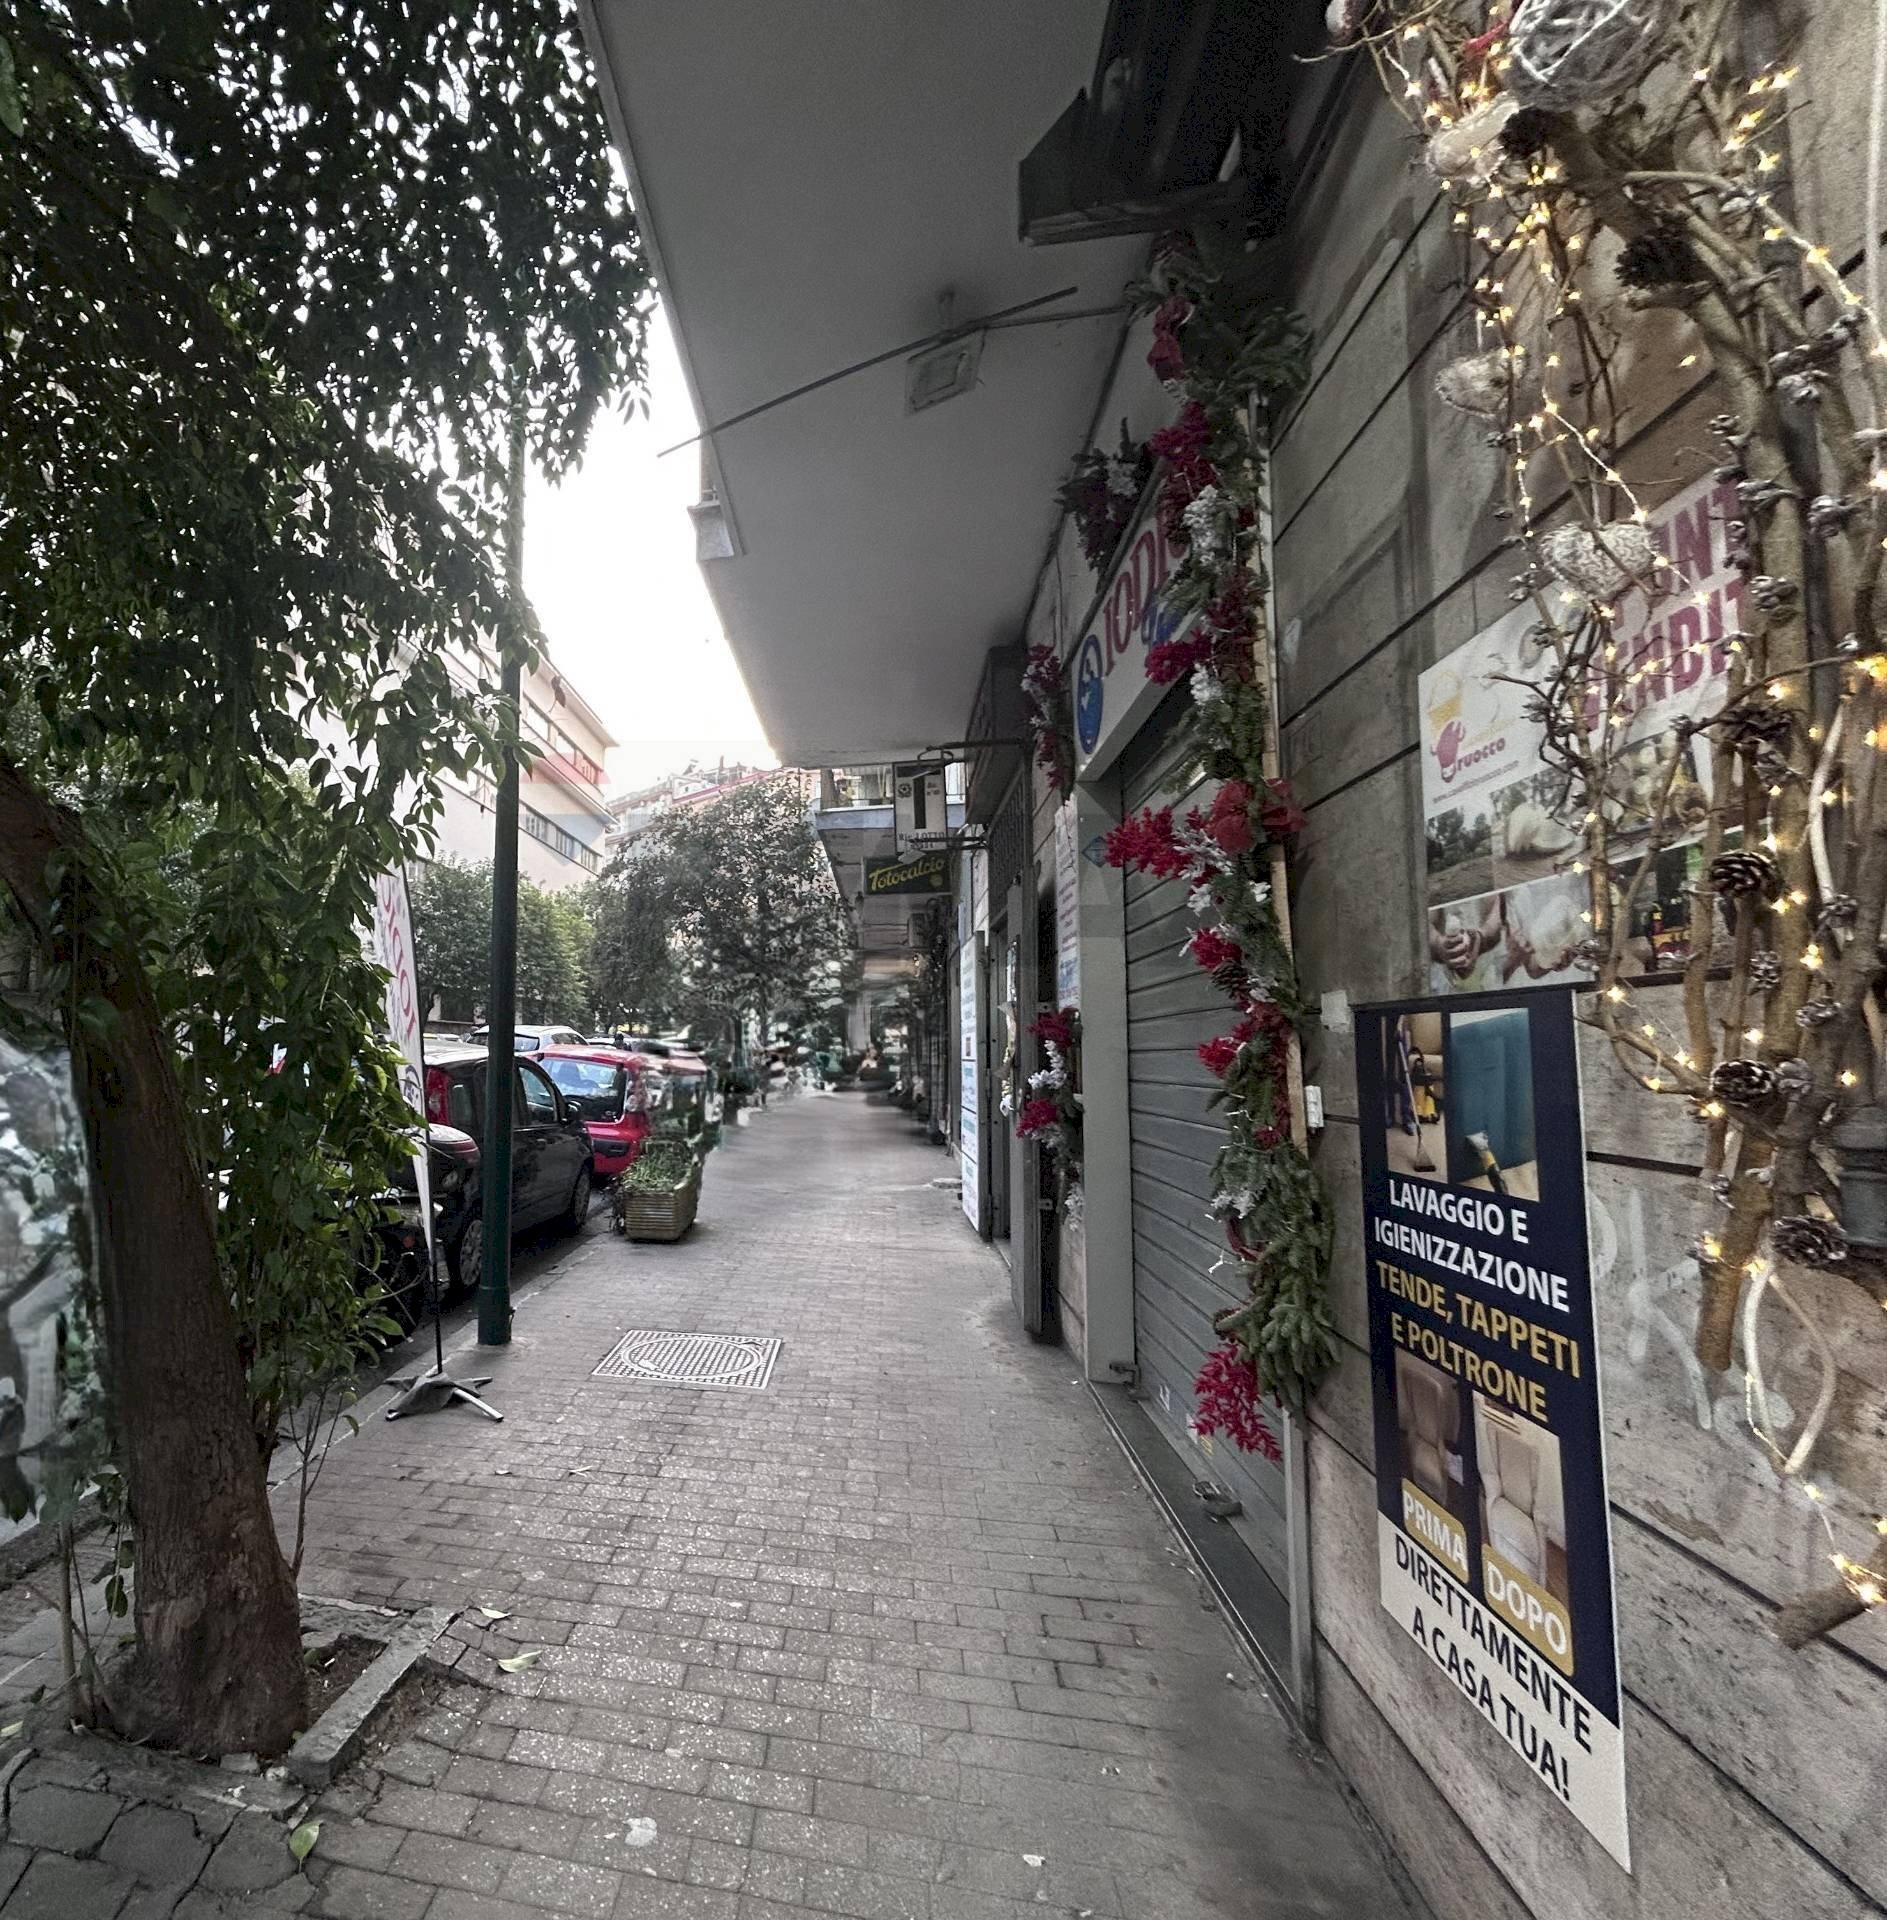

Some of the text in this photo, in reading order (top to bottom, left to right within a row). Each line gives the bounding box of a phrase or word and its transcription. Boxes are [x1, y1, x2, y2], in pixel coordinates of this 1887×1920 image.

[868, 857, 945, 891] Totocalcio
[1389, 1179, 1504, 1237] LAVAGGIO
[1512, 1210, 1529, 1244] E
[1375, 1215, 1570, 1313] IGIENIZZAZIONE
[1375, 1259, 1580, 1379] TENDE, TAPPETI
[1391, 1311, 1547, 1422] E POLTRONE
[1403, 1491, 1468, 1573] PRIMA
[1395, 1533, 1593, 1754] DIRETTAMENTE
[1488, 1562, 1567, 1656] DOPO
[1412, 1606, 1571, 1802] A CASA TUA!
